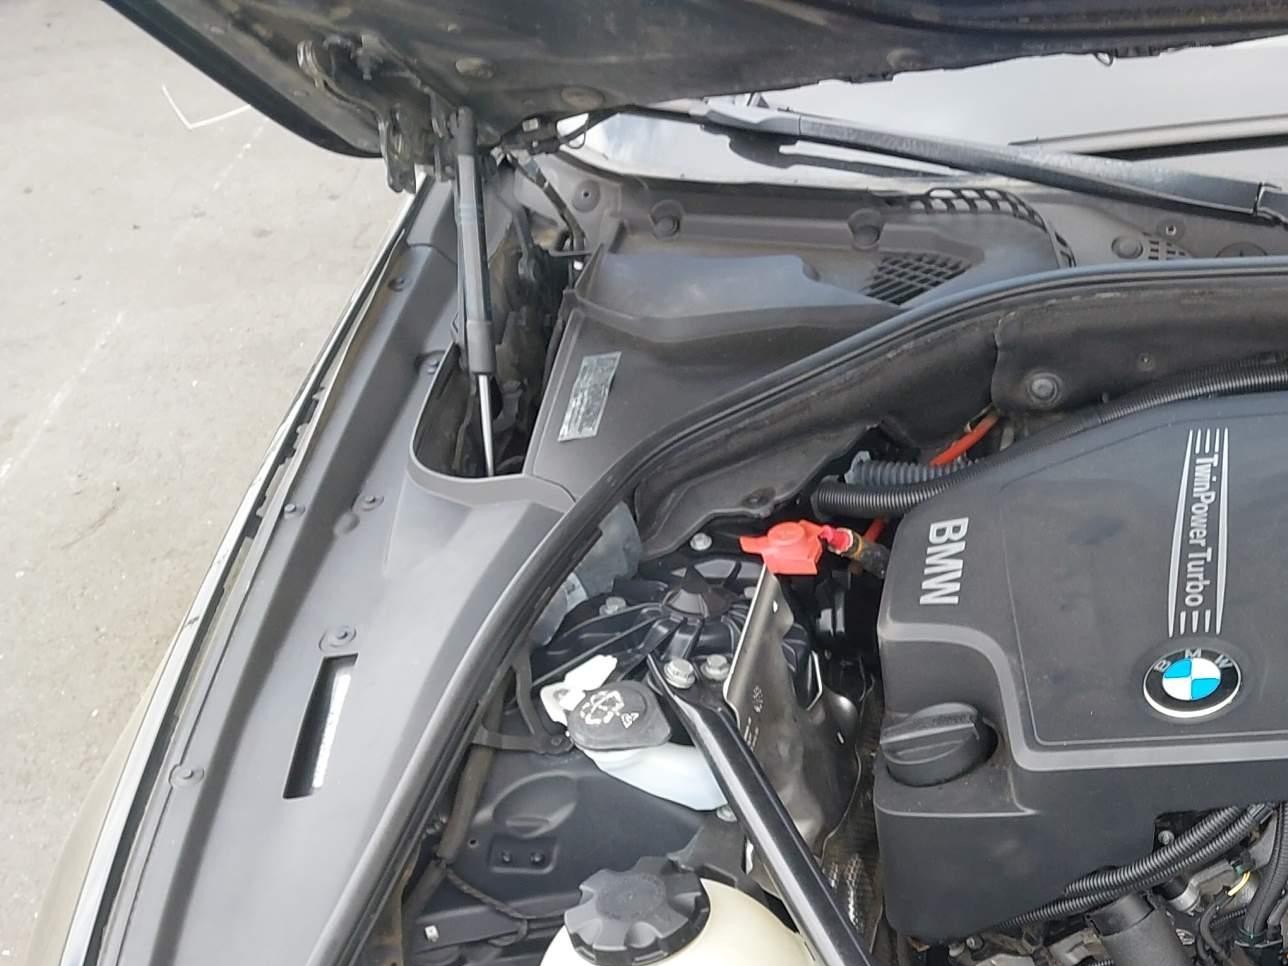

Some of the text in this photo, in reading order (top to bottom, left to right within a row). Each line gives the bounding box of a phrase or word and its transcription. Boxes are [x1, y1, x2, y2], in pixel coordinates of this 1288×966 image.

[919, 517, 969, 605] BMW
[1184, 453, 1219, 607] TwinPower Turbo
[1153, 648, 1233, 672] BMW
